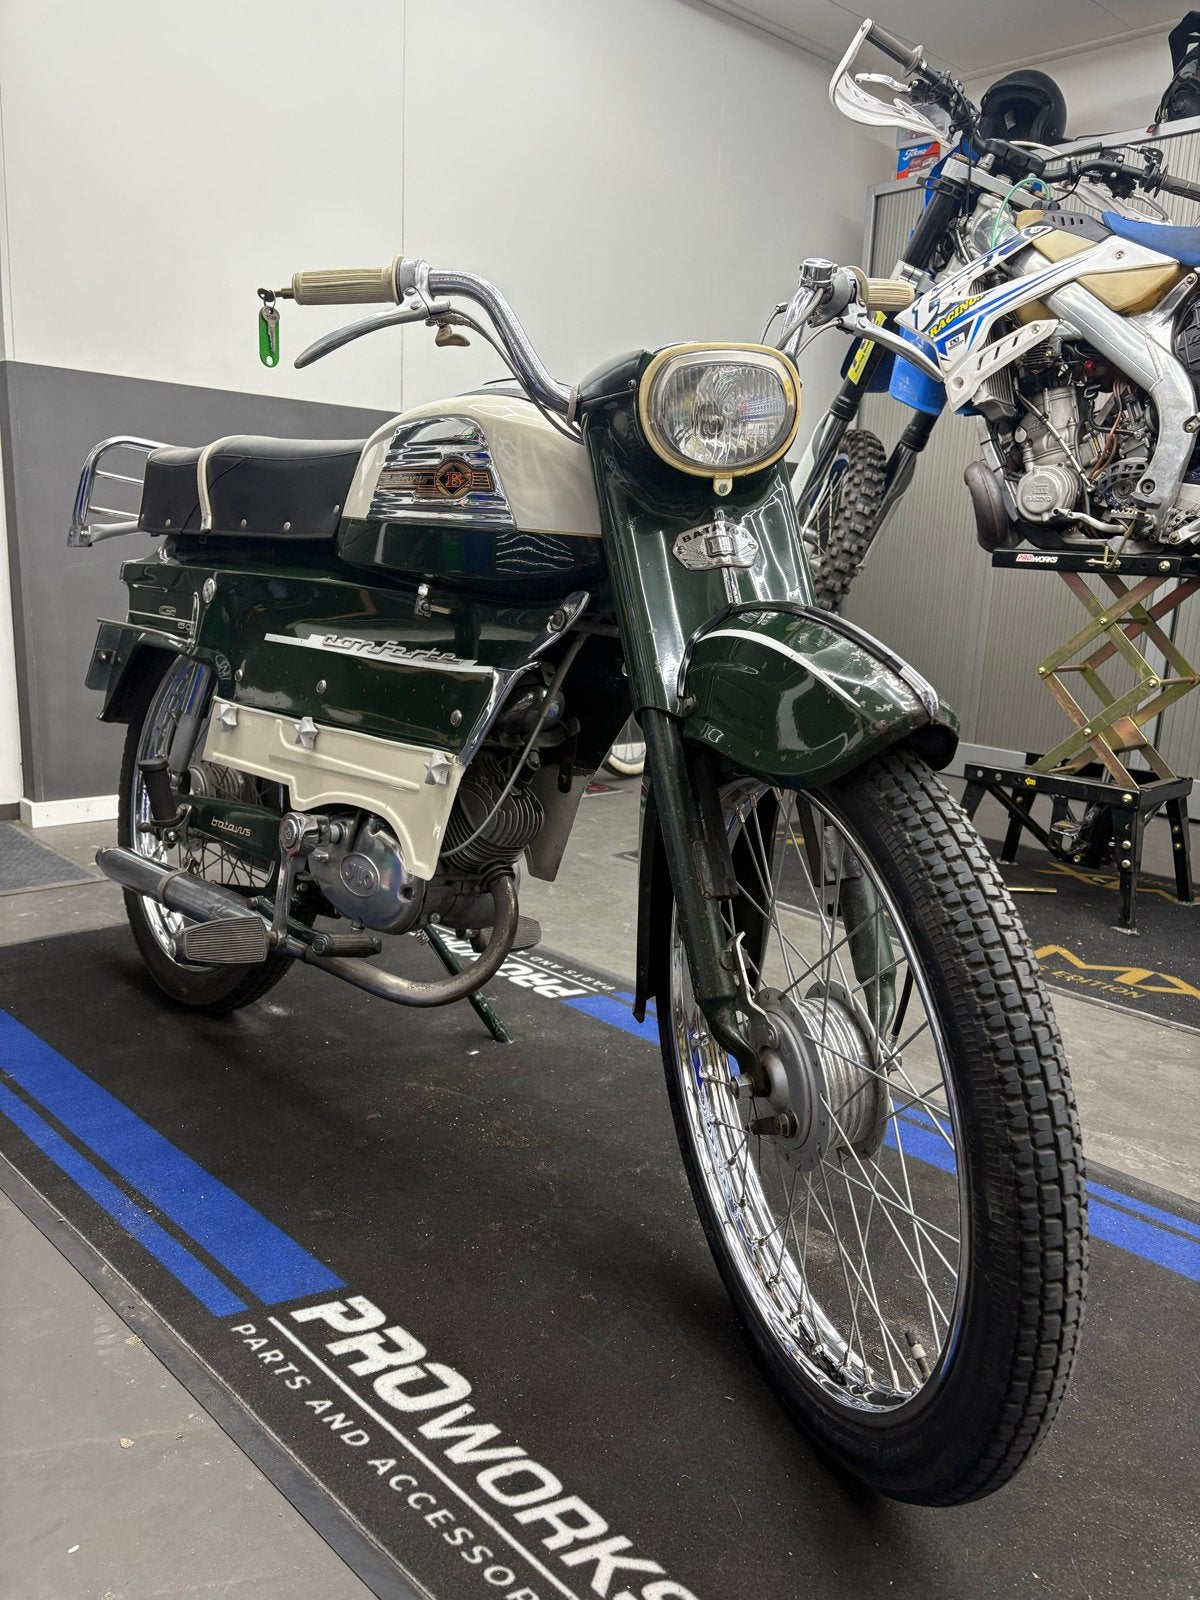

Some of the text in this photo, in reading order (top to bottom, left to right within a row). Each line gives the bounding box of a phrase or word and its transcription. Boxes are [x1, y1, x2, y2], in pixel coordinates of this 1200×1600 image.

[1016, 554, 1058, 563] PROWORKS
[529, 956, 616, 990] PARTS AND
[1051, 970, 1148, 999] EDITION
[231, 1323, 312, 1390] PARTS
[304, 1400, 370, 1446] AND
